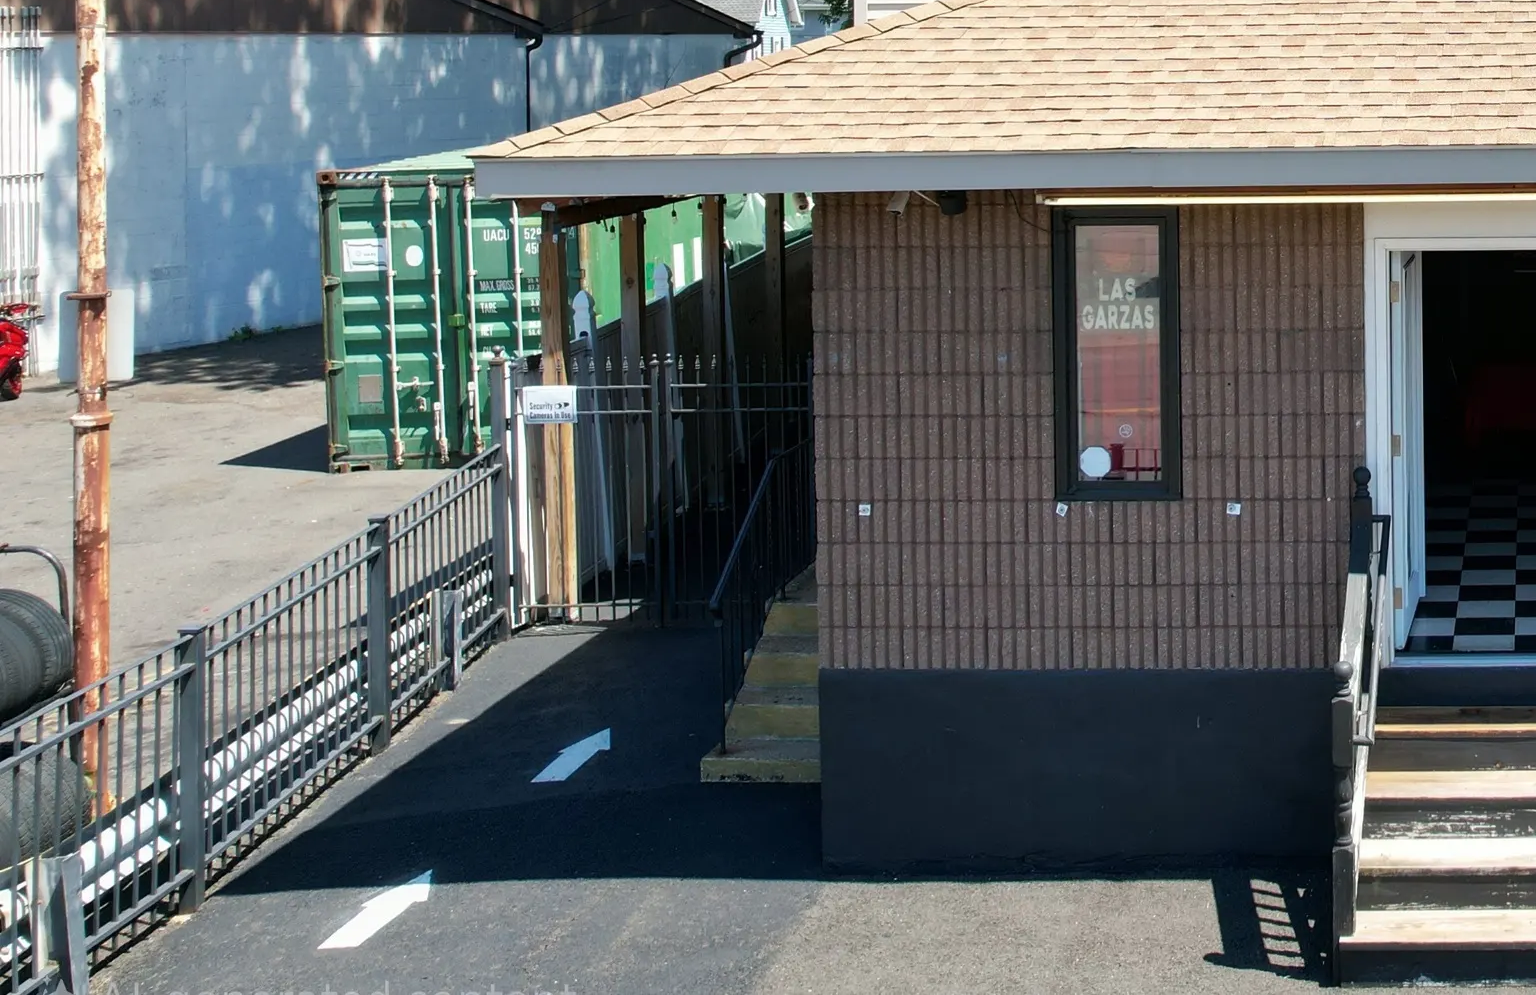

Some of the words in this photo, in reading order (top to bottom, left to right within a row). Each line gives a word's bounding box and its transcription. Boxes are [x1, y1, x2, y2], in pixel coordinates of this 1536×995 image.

[483, 228, 510, 241] UACU
[1098, 277, 1136, 302] LAS
[1082, 304, 1155, 330] GARZAS
[529, 402, 553, 411] Security
[529, 411, 553, 419] Cameras
[561, 411, 571, 419] Use
